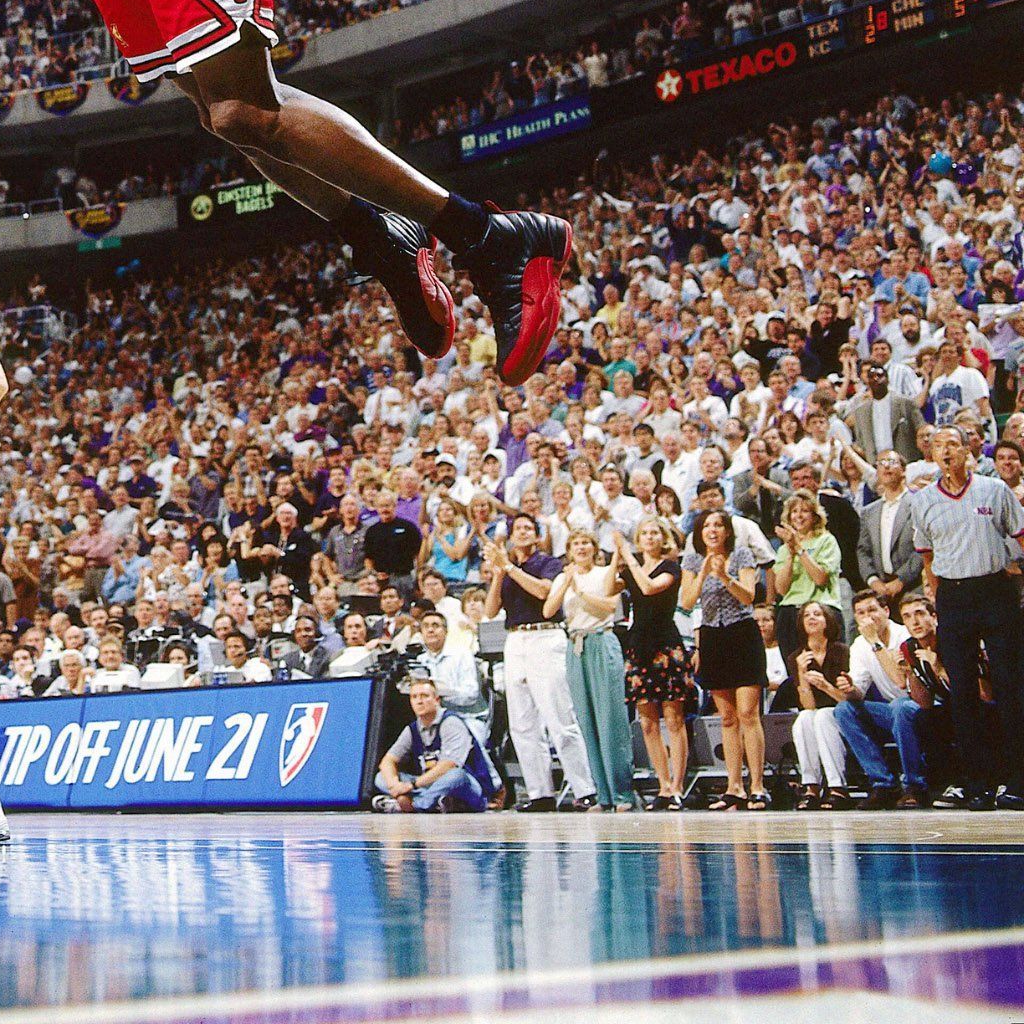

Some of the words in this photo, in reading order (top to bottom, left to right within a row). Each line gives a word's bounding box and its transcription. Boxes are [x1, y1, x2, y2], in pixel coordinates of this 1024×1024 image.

[807, 17, 840, 40] TEX
[865, 23, 876, 45] 2
[685, 42, 798, 94] TEXACO
[45, 720, 121, 786] OFF
[105, 715, 214, 789] JUNE
[206, 712, 269, 781] 21
